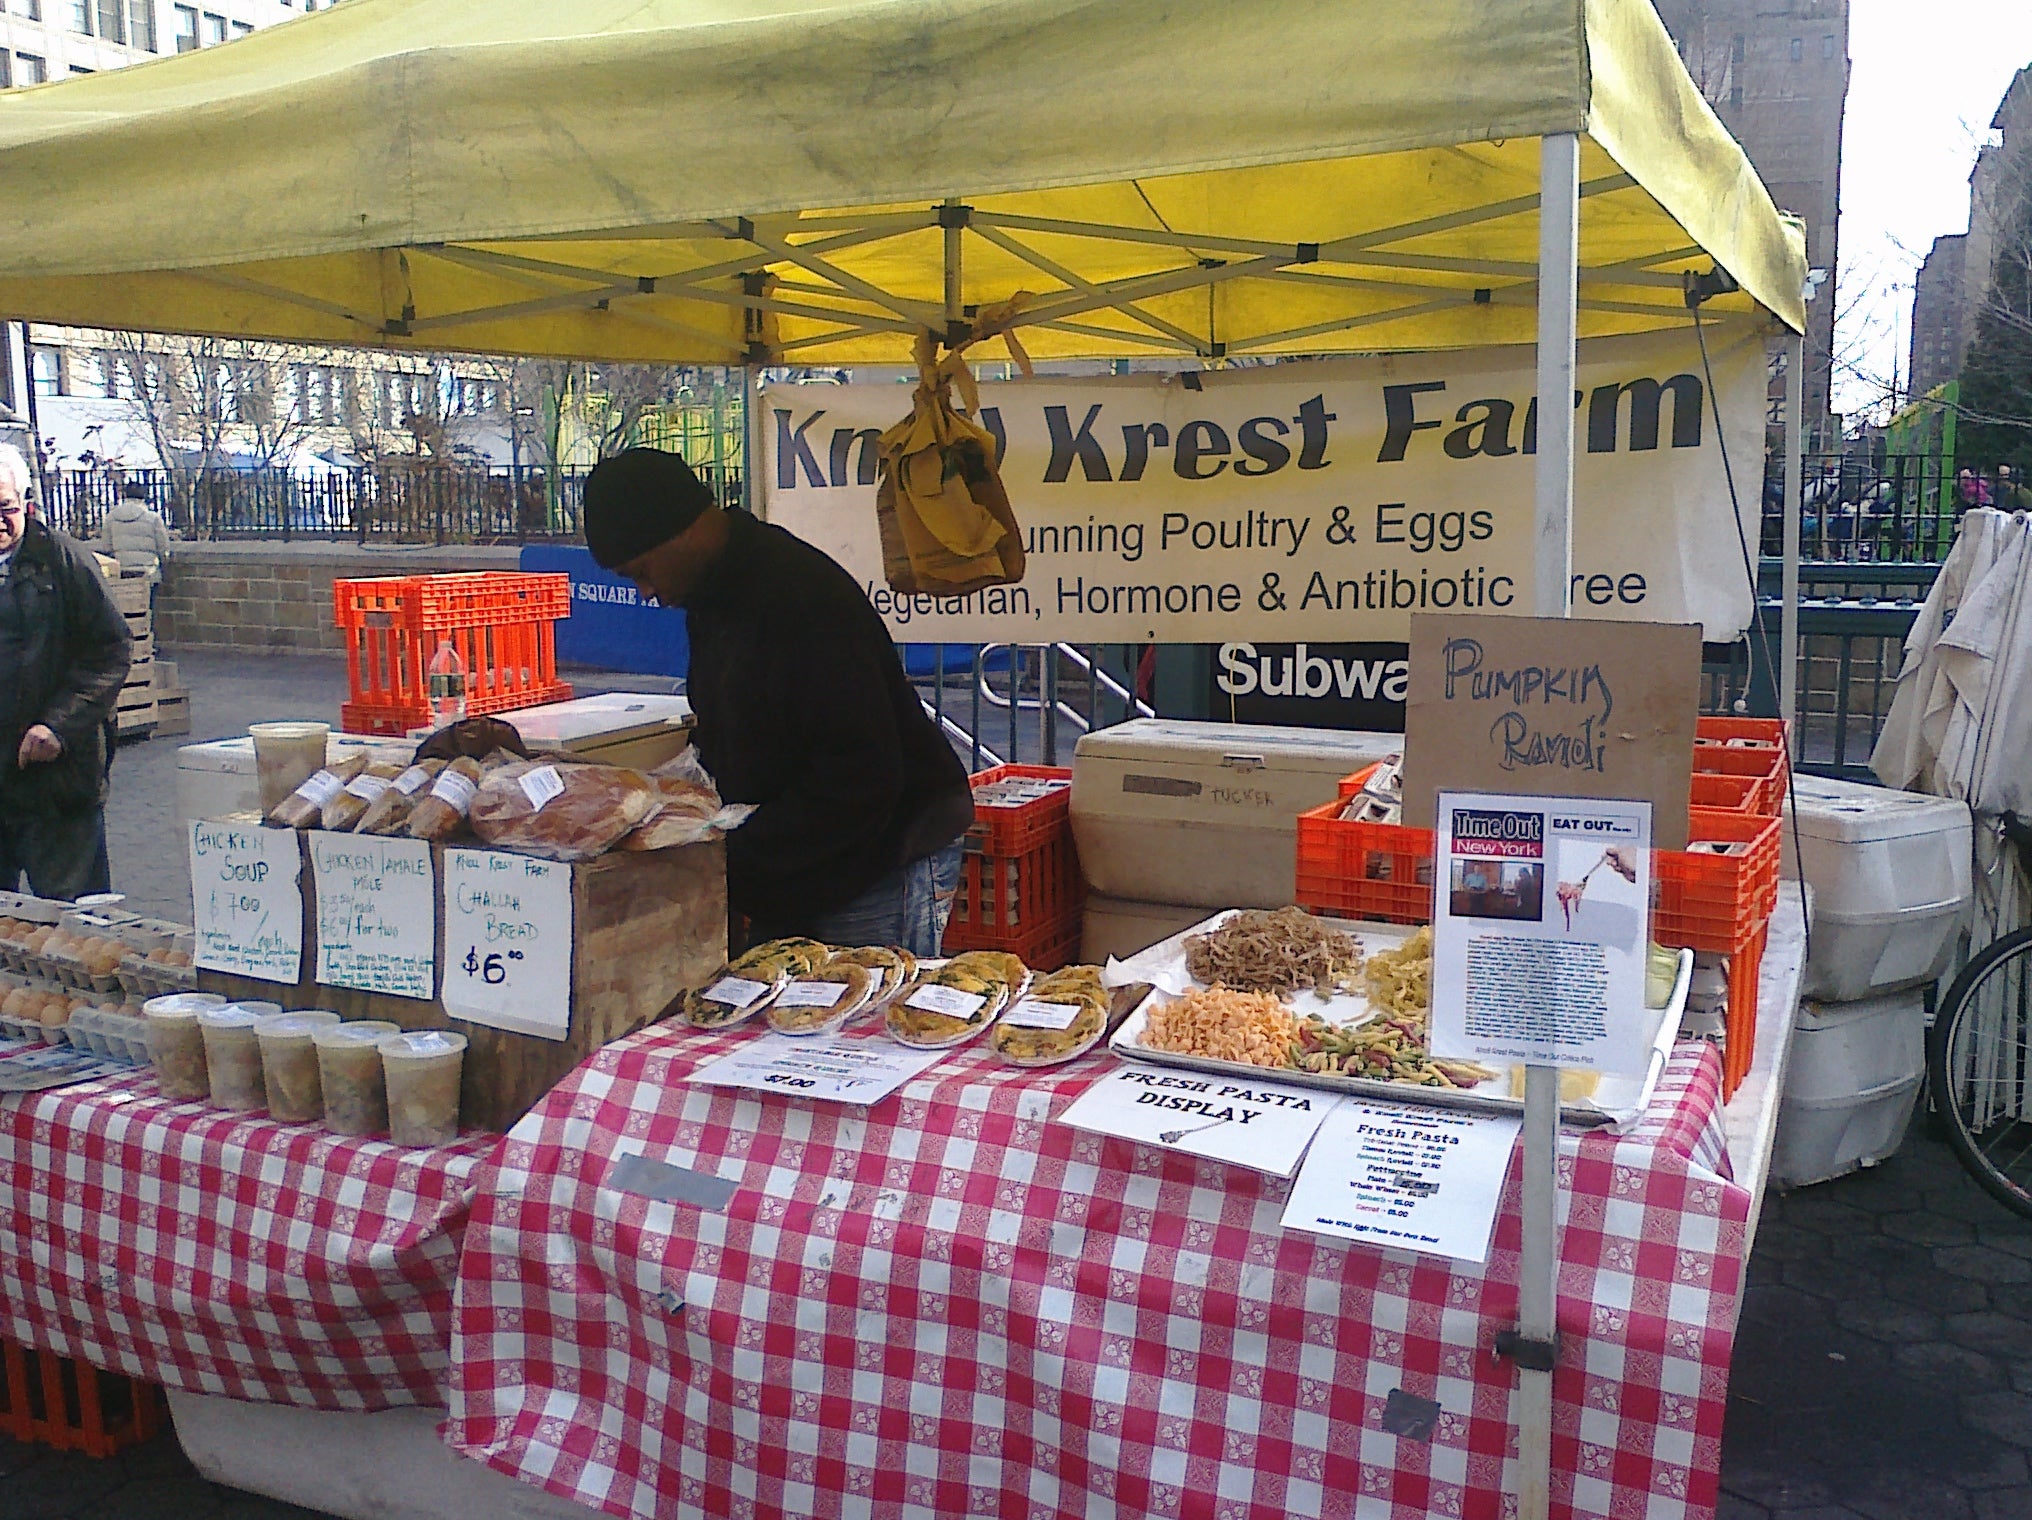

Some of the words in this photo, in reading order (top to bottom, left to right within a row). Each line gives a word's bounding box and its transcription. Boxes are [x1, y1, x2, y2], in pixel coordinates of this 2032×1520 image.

[1043, 394, 1336, 483] Krest
[1023, 515, 1144, 562] unning
[1161, 510, 1310, 557] Poultry
[1326, 505, 1357, 545] &
[1376, 503, 1494, 553] Eggs
[579, 582, 637, 605] SQUARE
[866, 579, 1041, 624] egetarian,
[1057, 576, 1241, 614] Hormone
[1258, 572, 1287, 611] &
[1299, 566, 1515, 610] Antibiotic
[1570, 572, 1647, 606] ree
[1217, 642, 1409, 702] Subwa
[1454, 811, 1501, 838] Time
[1503, 812, 1541, 840] Out
[1553, 818, 1580, 830] EAT
[1456, 839, 1497, 854] New
[1498, 841, 1538, 857] York
[220, 855, 270, 882] SOUP
[484, 912, 540, 943] BREAD
[1118, 1072, 1214, 1093] FRESH
[1217, 1086, 1312, 1112] PASTA
[1136, 1091, 1262, 1124] DISPLAY
[1356, 1123, 1407, 1140] Fresh
[1411, 1129, 1460, 1146] Pasta
